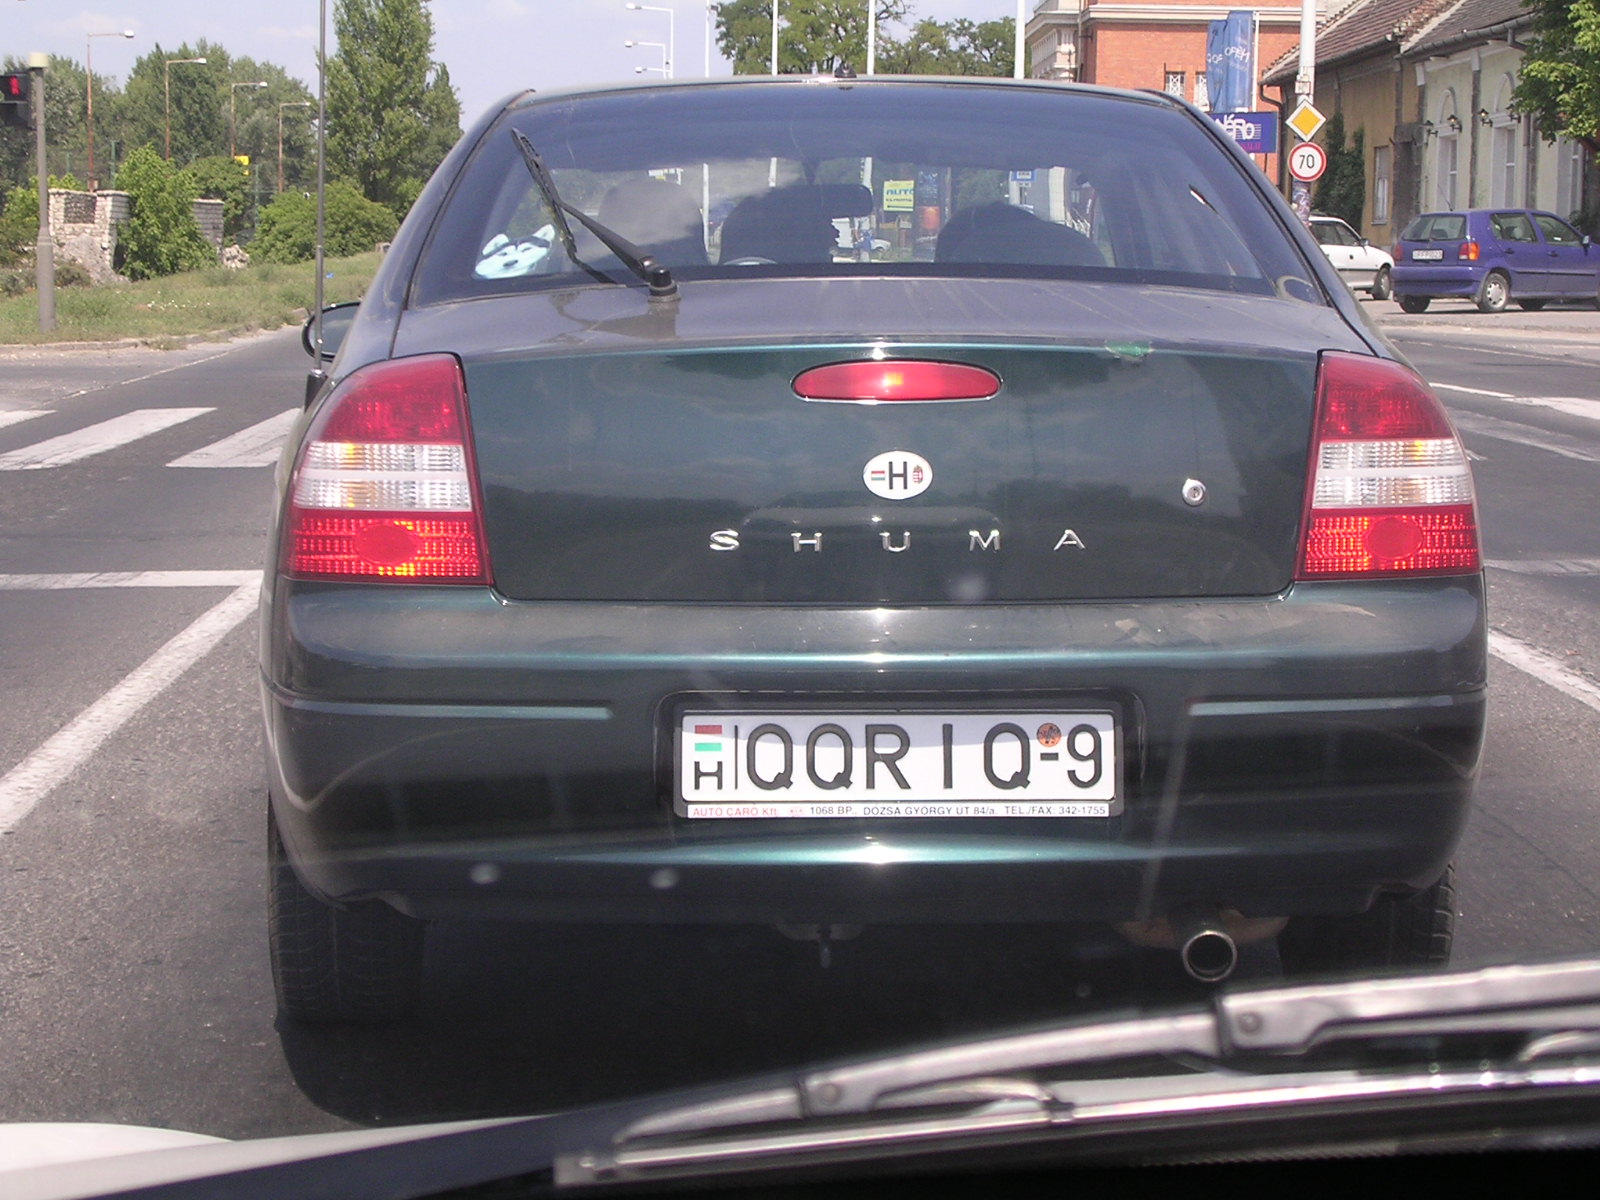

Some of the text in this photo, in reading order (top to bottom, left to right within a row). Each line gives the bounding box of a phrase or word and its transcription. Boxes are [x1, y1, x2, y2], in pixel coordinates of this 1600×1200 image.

[1299, 154, 1315, 169] 70
[888, 461, 908, 490] H
[709, 529, 1086, 553] SHUMA
[694, 761, 723, 790] H
[810, 806, 834, 815] 1068
[1058, 805, 1106, 815] 342-1755
